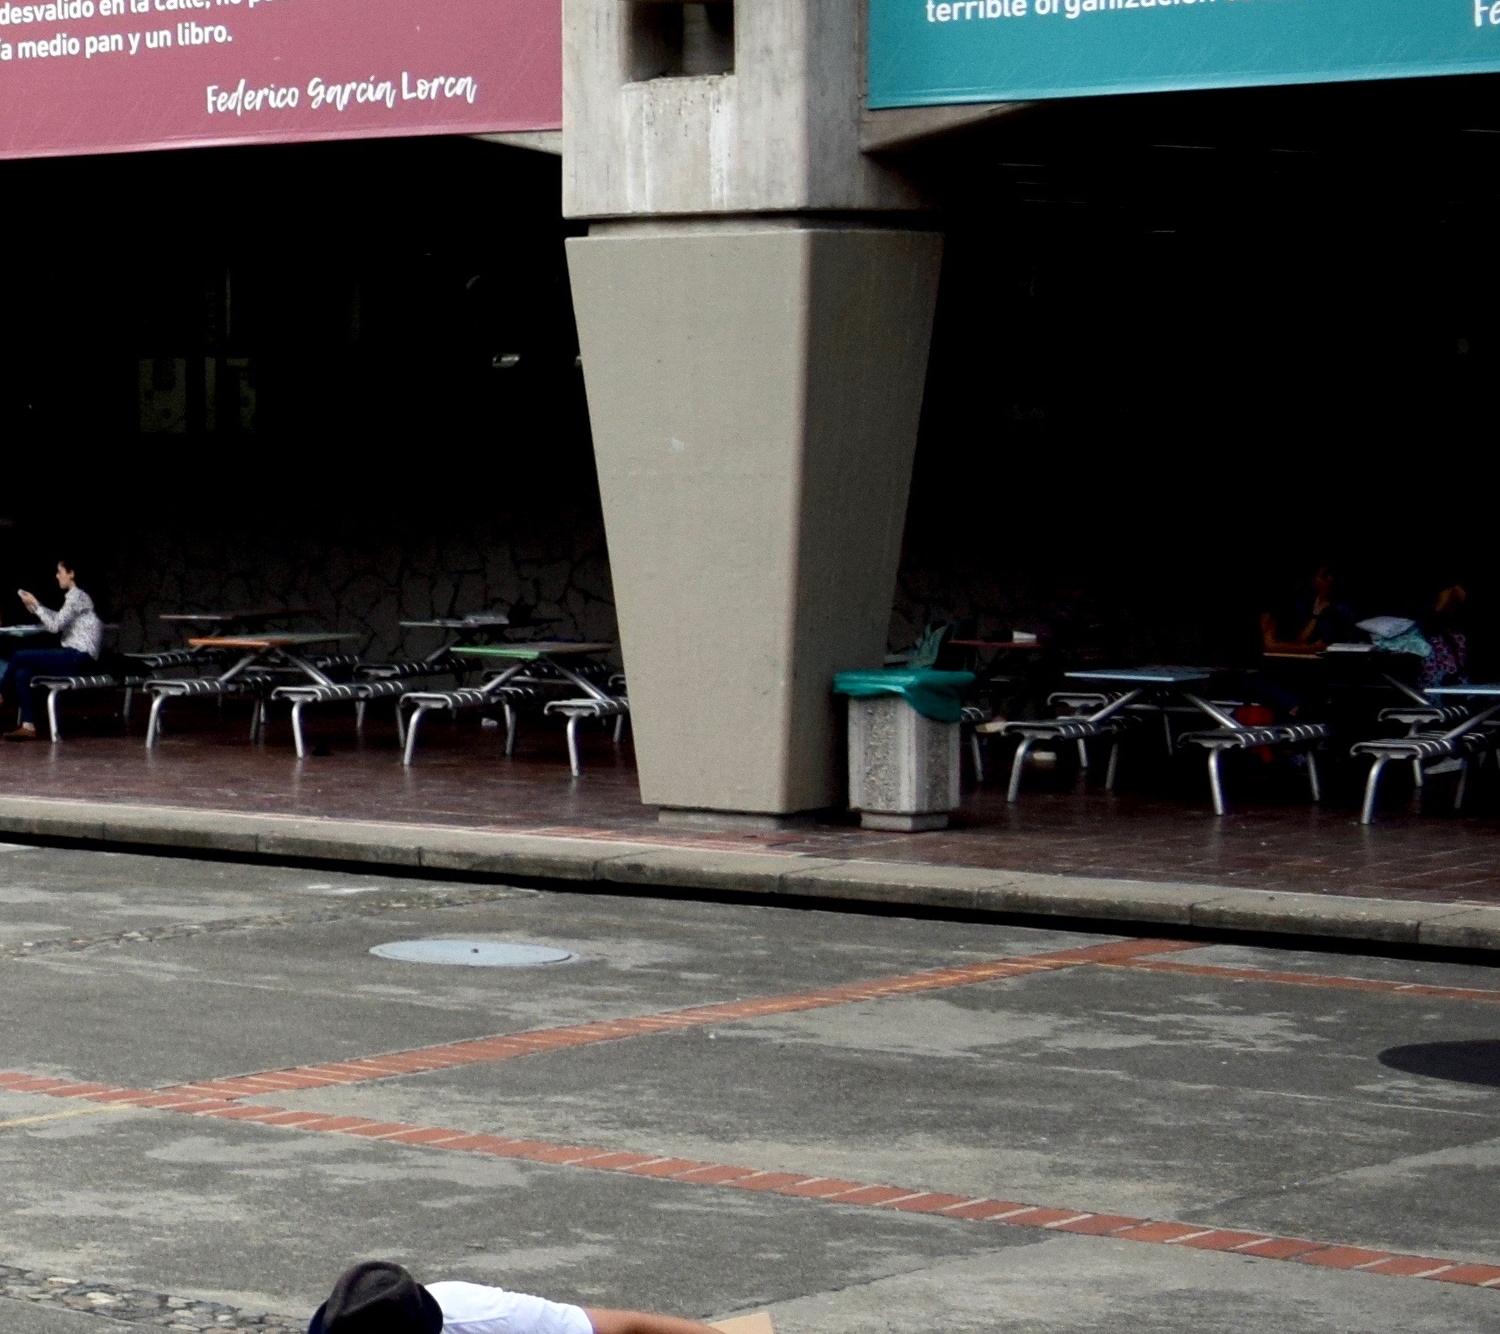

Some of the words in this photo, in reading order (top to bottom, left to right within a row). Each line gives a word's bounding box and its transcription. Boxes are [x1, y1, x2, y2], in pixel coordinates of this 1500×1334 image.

[18, 33, 80, 58] medio
[86, 35, 123, 58] pan
[128, 33, 140, 55] y
[146, 30, 171, 48] un
[178, 22, 232, 46] libro.
[207, 79, 299, 116] Federico
[308, 76, 396, 111] García
[402, 72, 477, 103] Lorca
